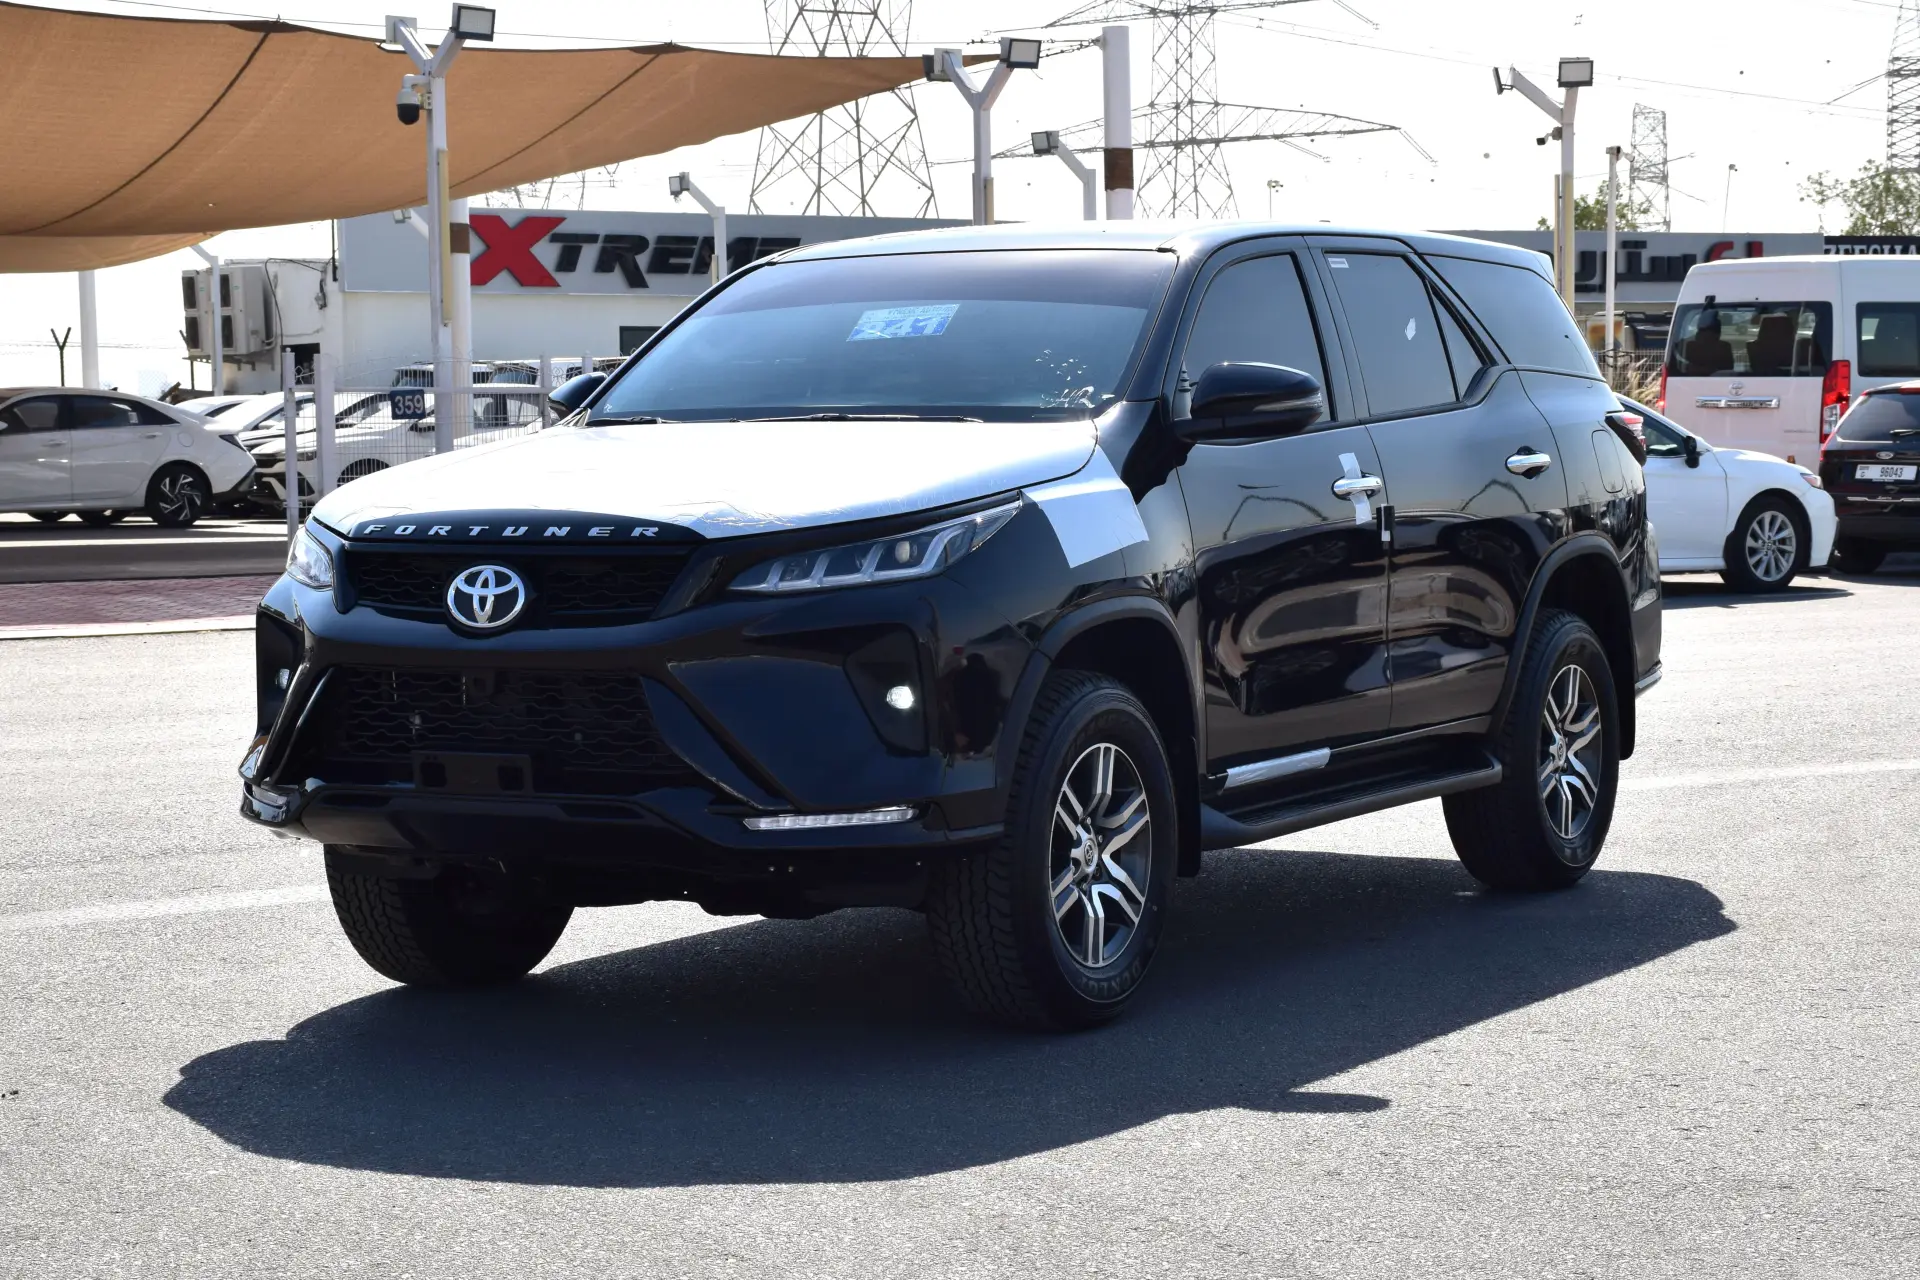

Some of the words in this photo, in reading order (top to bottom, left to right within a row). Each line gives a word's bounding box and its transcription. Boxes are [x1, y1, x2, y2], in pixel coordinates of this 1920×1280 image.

[394, 394, 424, 415] 359
[1880, 466, 1904, 478] 96043
[363, 524, 659, 538] FORTUNER
